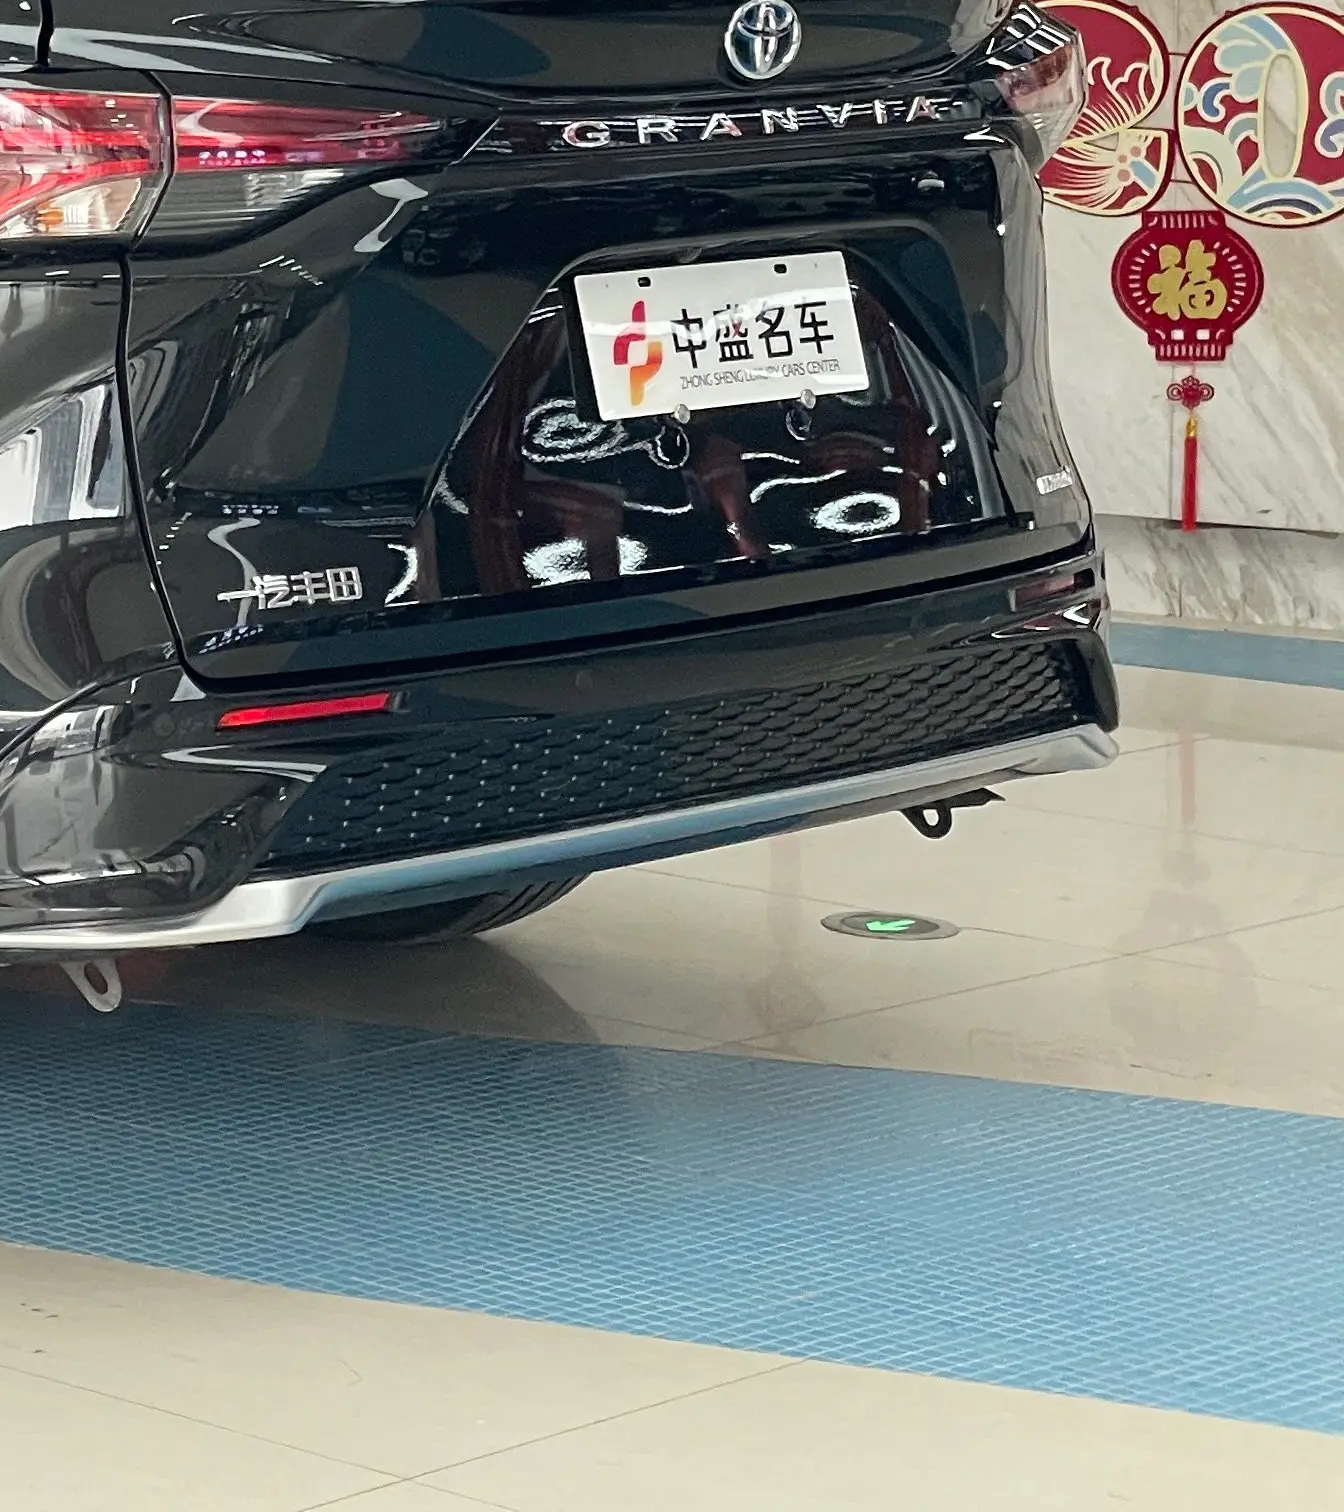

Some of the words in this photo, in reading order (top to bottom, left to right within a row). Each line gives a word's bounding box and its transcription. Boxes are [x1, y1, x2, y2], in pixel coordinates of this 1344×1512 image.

[561, 95, 940, 149] GRANVIA
[1146, 238, 1229, 321] 福
[670, 299, 836, 370] 中盛名车
[679, 372, 714, 390] ZHONG
[714, 366, 744, 386] SHENG
[806, 355, 841, 375] CENTER
[216, 566, 363, 610] 一汽丰田
